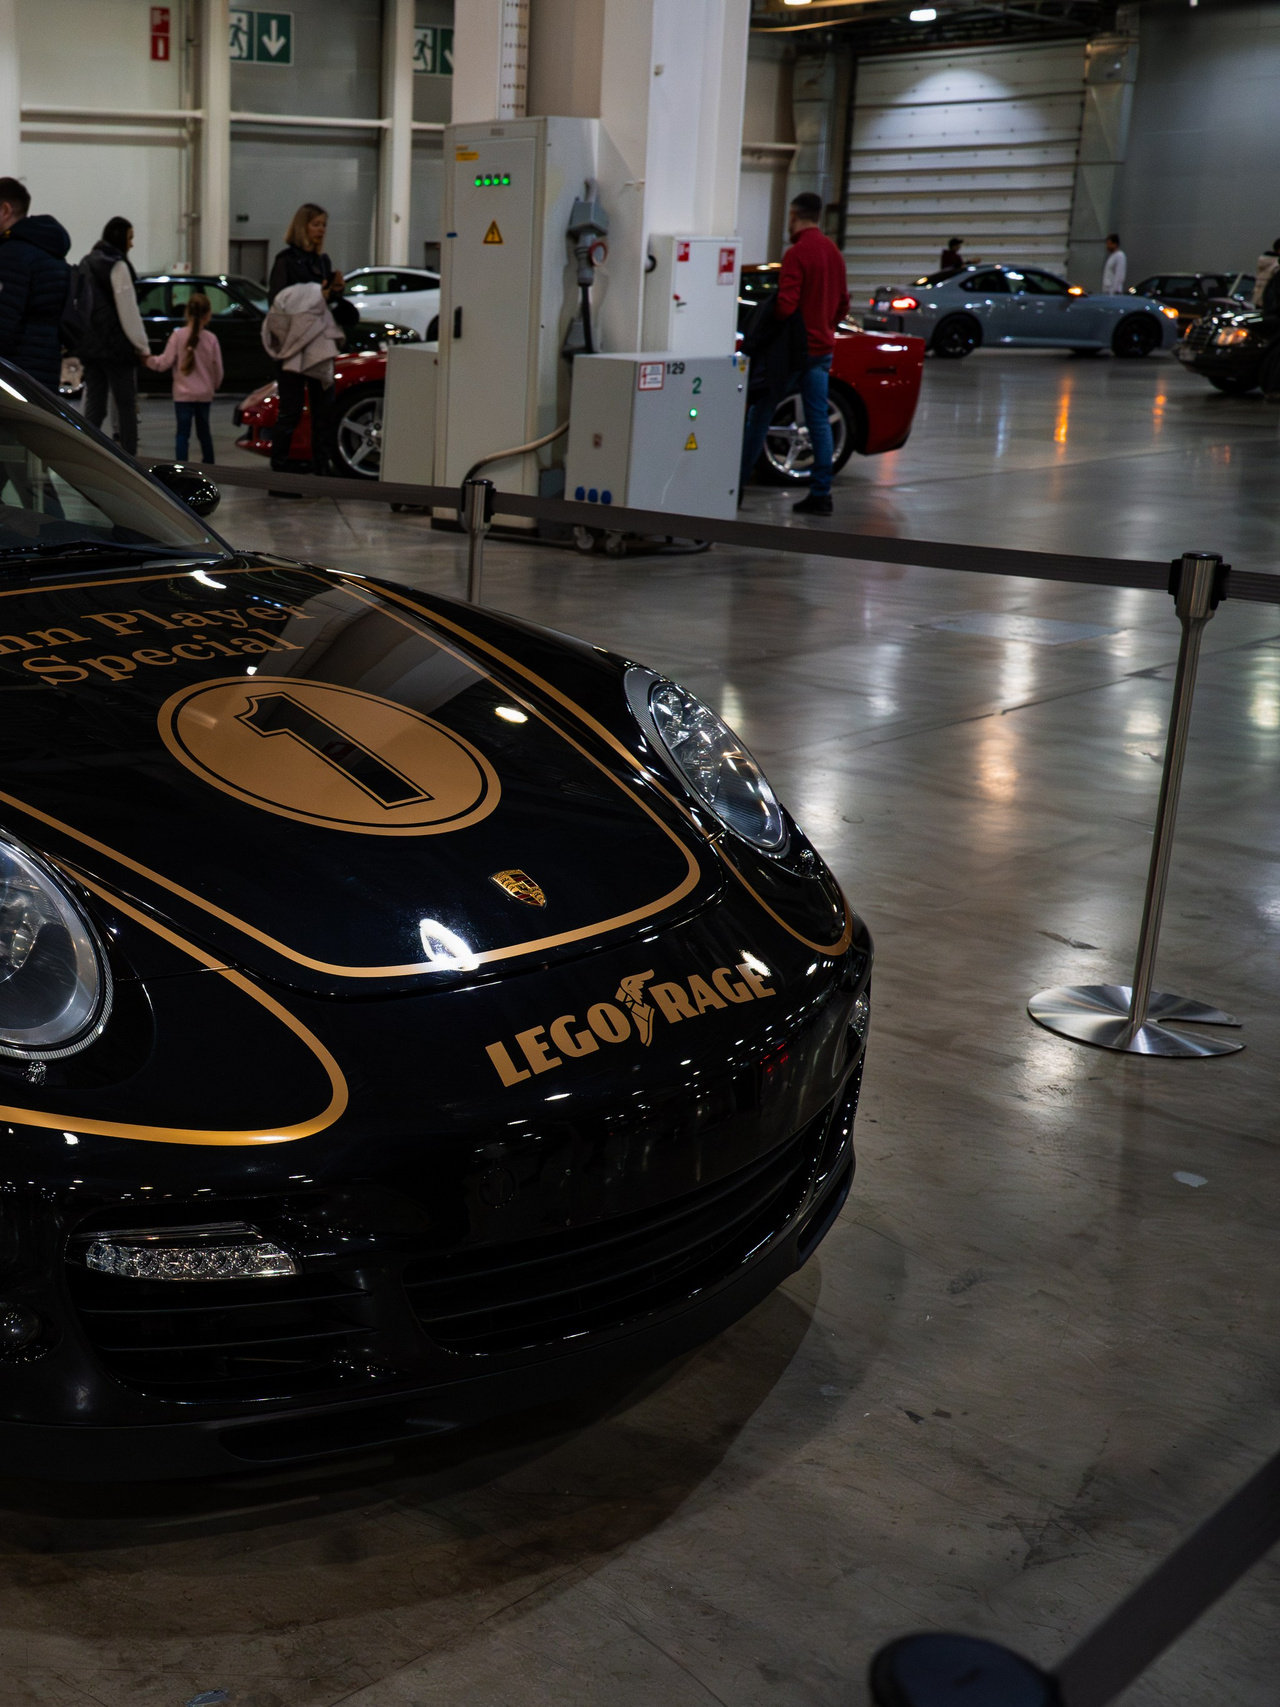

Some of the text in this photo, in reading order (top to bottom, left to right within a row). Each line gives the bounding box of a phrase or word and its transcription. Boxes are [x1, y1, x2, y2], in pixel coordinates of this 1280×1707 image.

[666, 362, 685, 375] 129
[692, 377, 702, 394] 2
[80, 604, 315, 637] Player
[22, 628, 305, 686] Special
[234, 691, 435, 810] 1
[485, 963, 777, 1088] LEGO RAGE
